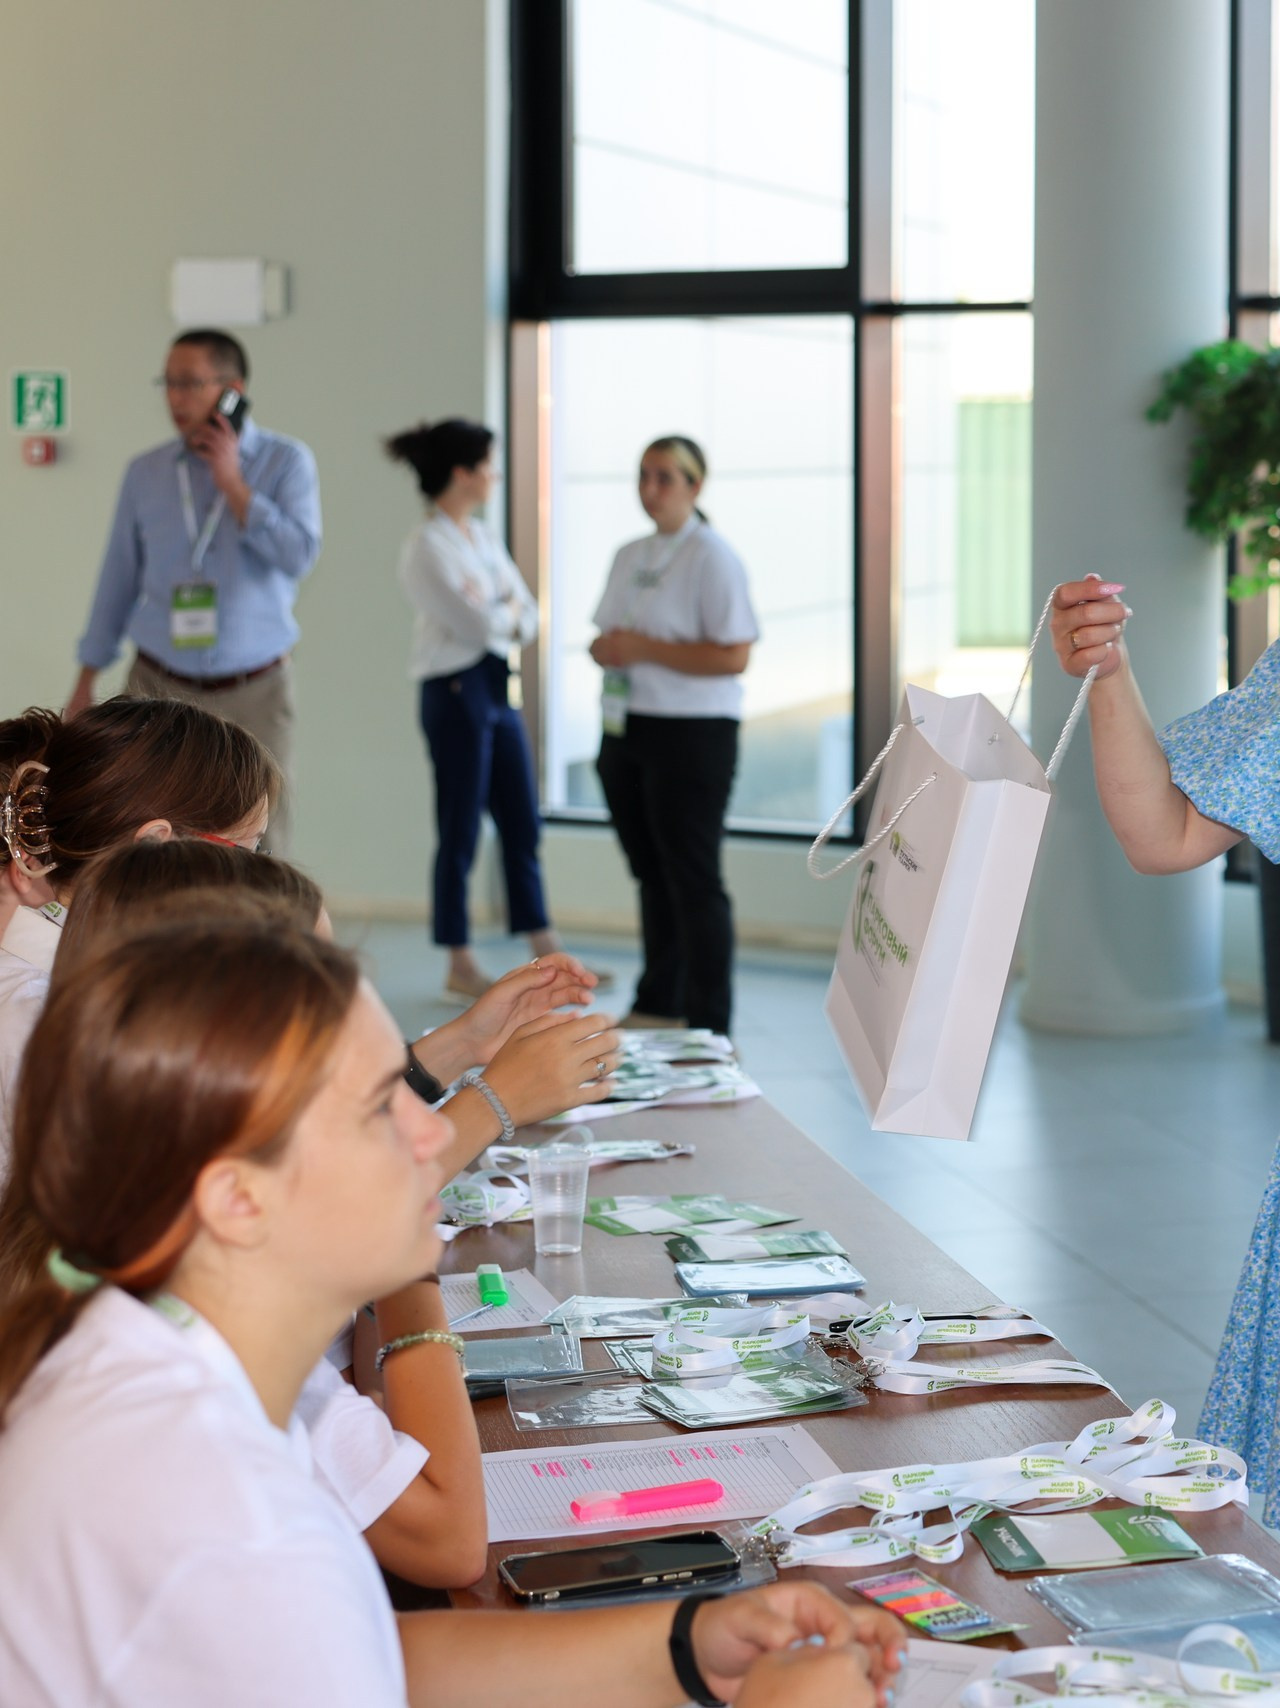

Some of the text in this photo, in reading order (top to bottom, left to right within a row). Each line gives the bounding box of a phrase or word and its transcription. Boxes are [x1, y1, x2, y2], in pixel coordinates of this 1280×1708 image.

[867, 891, 908, 967] ПАРКОВЫЙ
[864, 916, 885, 967] ФОРУМ
[1185, 1450, 1207, 1458] ФОРУМ
[1175, 1456, 1207, 1466] ПАРКОВЫЙ
[902, 1470, 935, 1478] ПАРКОВЫЙ
[904, 1477, 926, 1485] ФОРУМ
